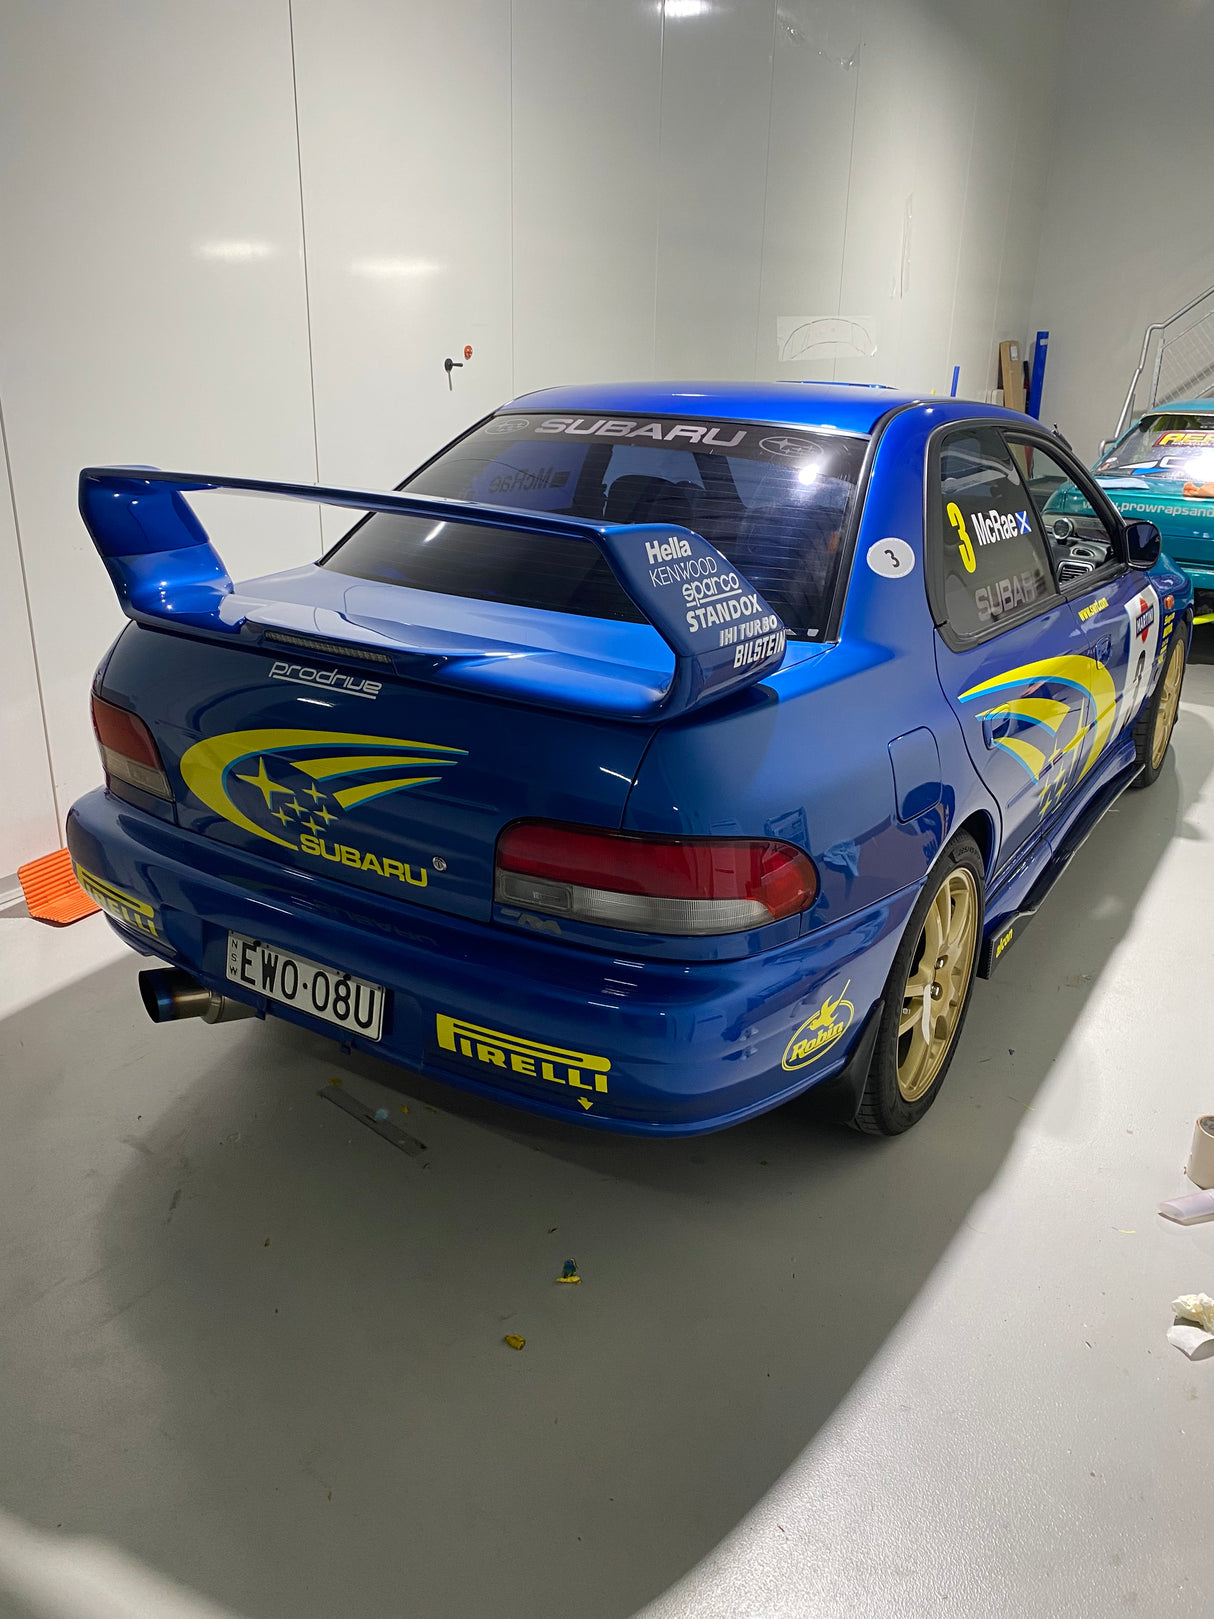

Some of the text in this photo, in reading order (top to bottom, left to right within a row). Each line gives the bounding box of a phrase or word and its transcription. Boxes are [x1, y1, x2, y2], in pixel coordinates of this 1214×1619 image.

[534, 418, 747, 447] SUBARU
[645, 536, 692, 564] Hella
[946, 502, 1018, 573] 3 McRae
[649, 556, 717, 587] KENWOOD
[884, 549, 900, 568] 3
[682, 572, 741, 606] sparco
[686, 594, 762, 633] STANDOX
[720, 614, 778, 646] IHI TURBO
[733, 629, 787, 668] BILSTEIN
[269, 661, 383, 698] prodrive
[300, 833, 428, 887] SUBARU
[76, 863, 158, 937] PIRELLI
[436, 1013, 611, 1093] PIRELLI
[789, 1021, 844, 1062] Robin
